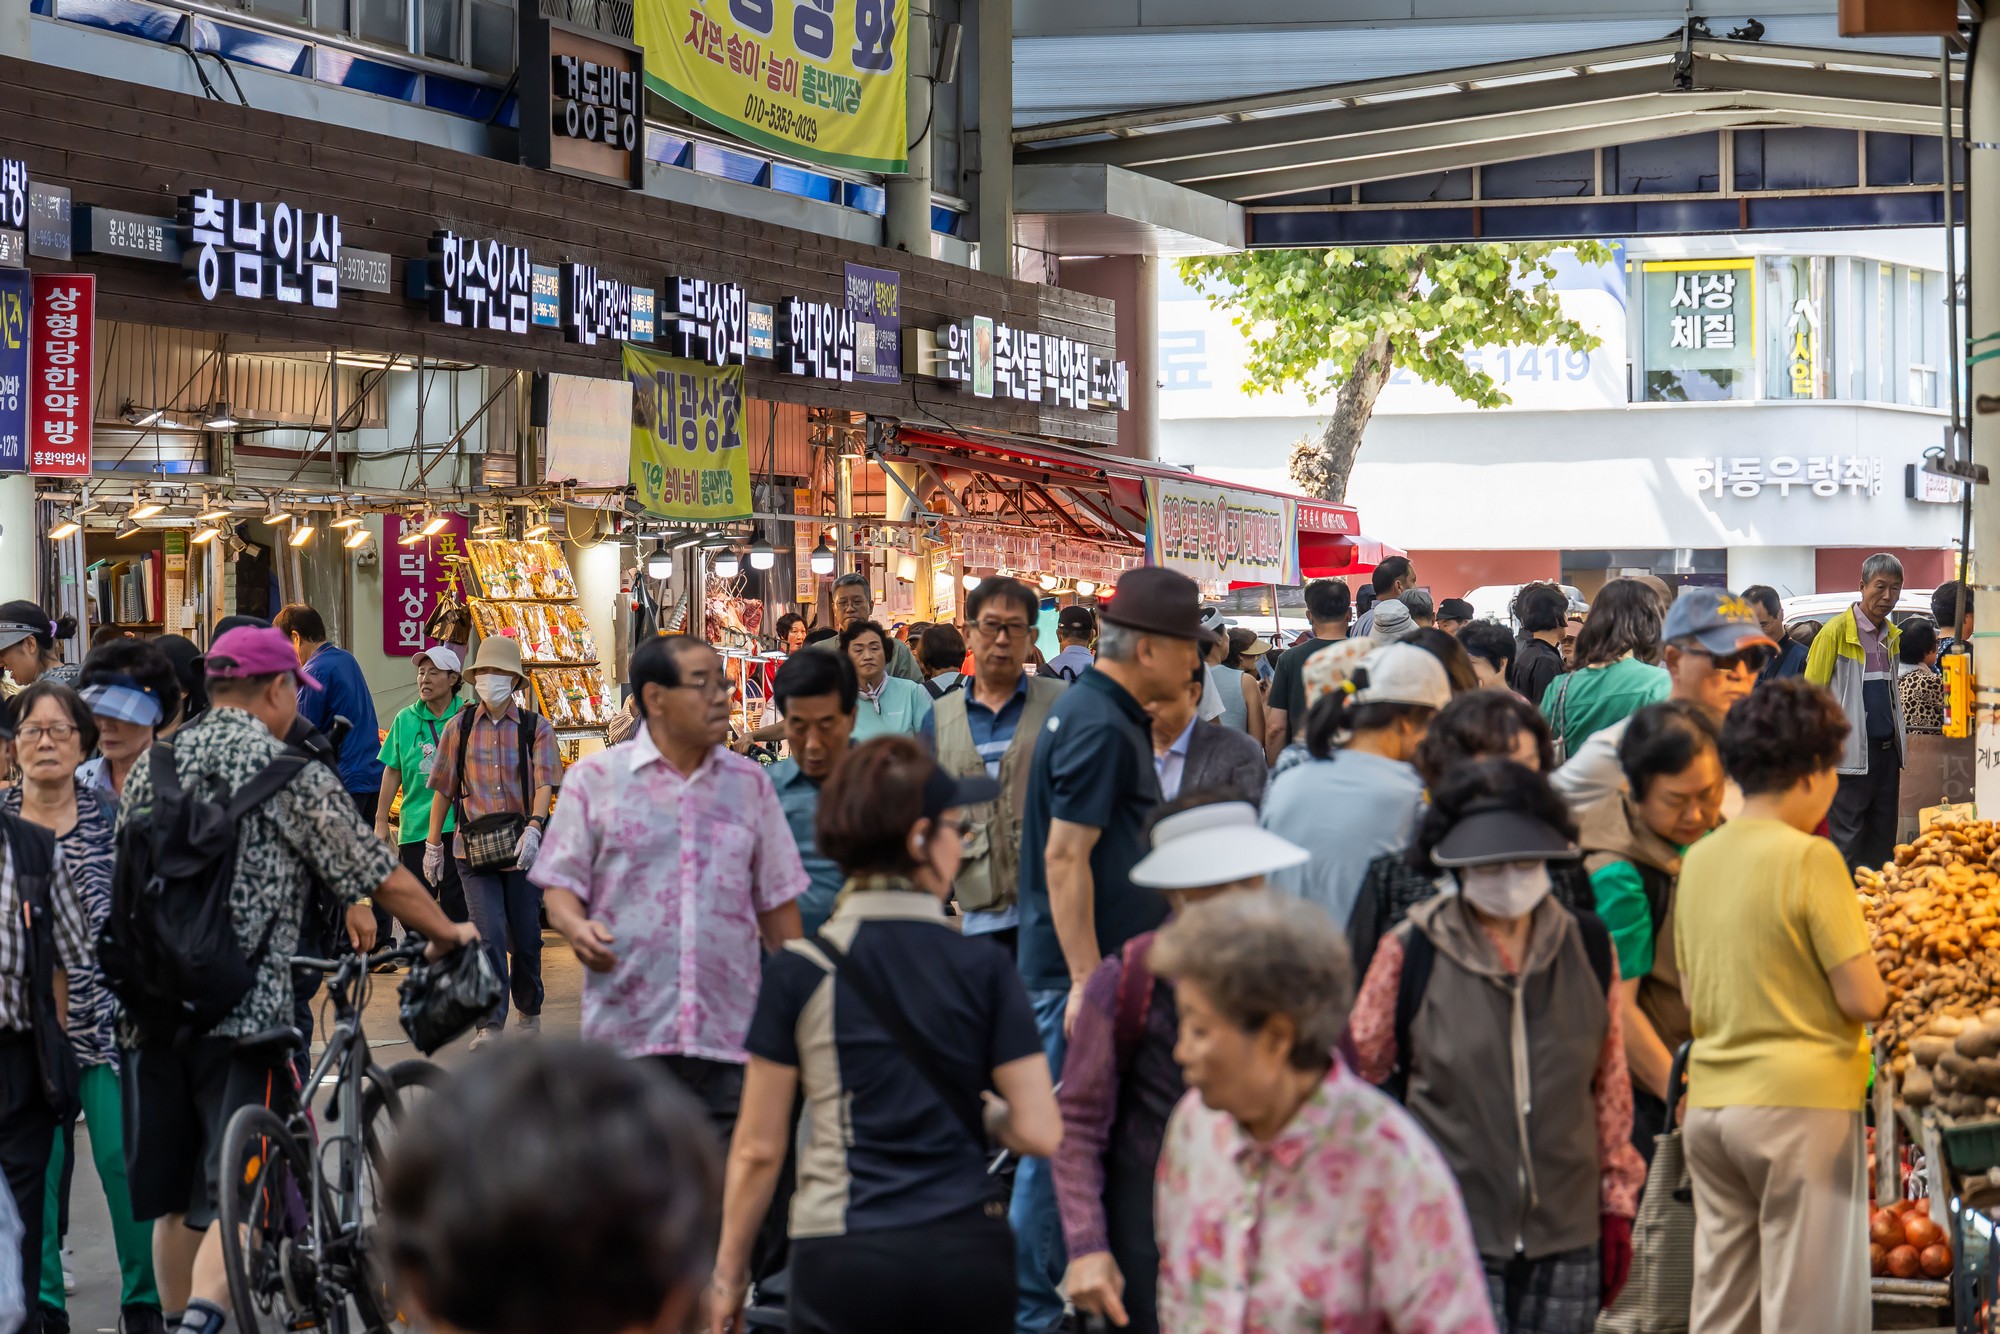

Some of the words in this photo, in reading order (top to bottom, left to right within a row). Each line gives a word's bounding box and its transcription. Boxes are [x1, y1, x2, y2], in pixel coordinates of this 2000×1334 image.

[561, 54, 637, 152] 경동빌딩
[685, 9, 725, 64] 자연
[802, 65, 862, 114] 총판매장
[744, 93, 818, 143] 010-5353-0029
[109, 218, 163, 252] 홍삼,인삼,벌꿀
[193, 189, 342, 308] 충남인삼
[442, 231, 531, 334] 한수인삼
[574, 263, 632, 345] 대산고려인삼
[678, 276, 746, 367] 부덕상회
[875, 280, 898, 317] 확장이전
[1670, 273, 1736, 310] 사상
[44, 287, 81, 445] 상형당한약방
[790, 296, 854, 382] 현대인삼
[948, 323, 971, 382] 은진
[1670, 314, 1736, 349] 체질
[656, 370, 742, 454] 대광상회
[34, 451, 86, 467] 흥환약업사
